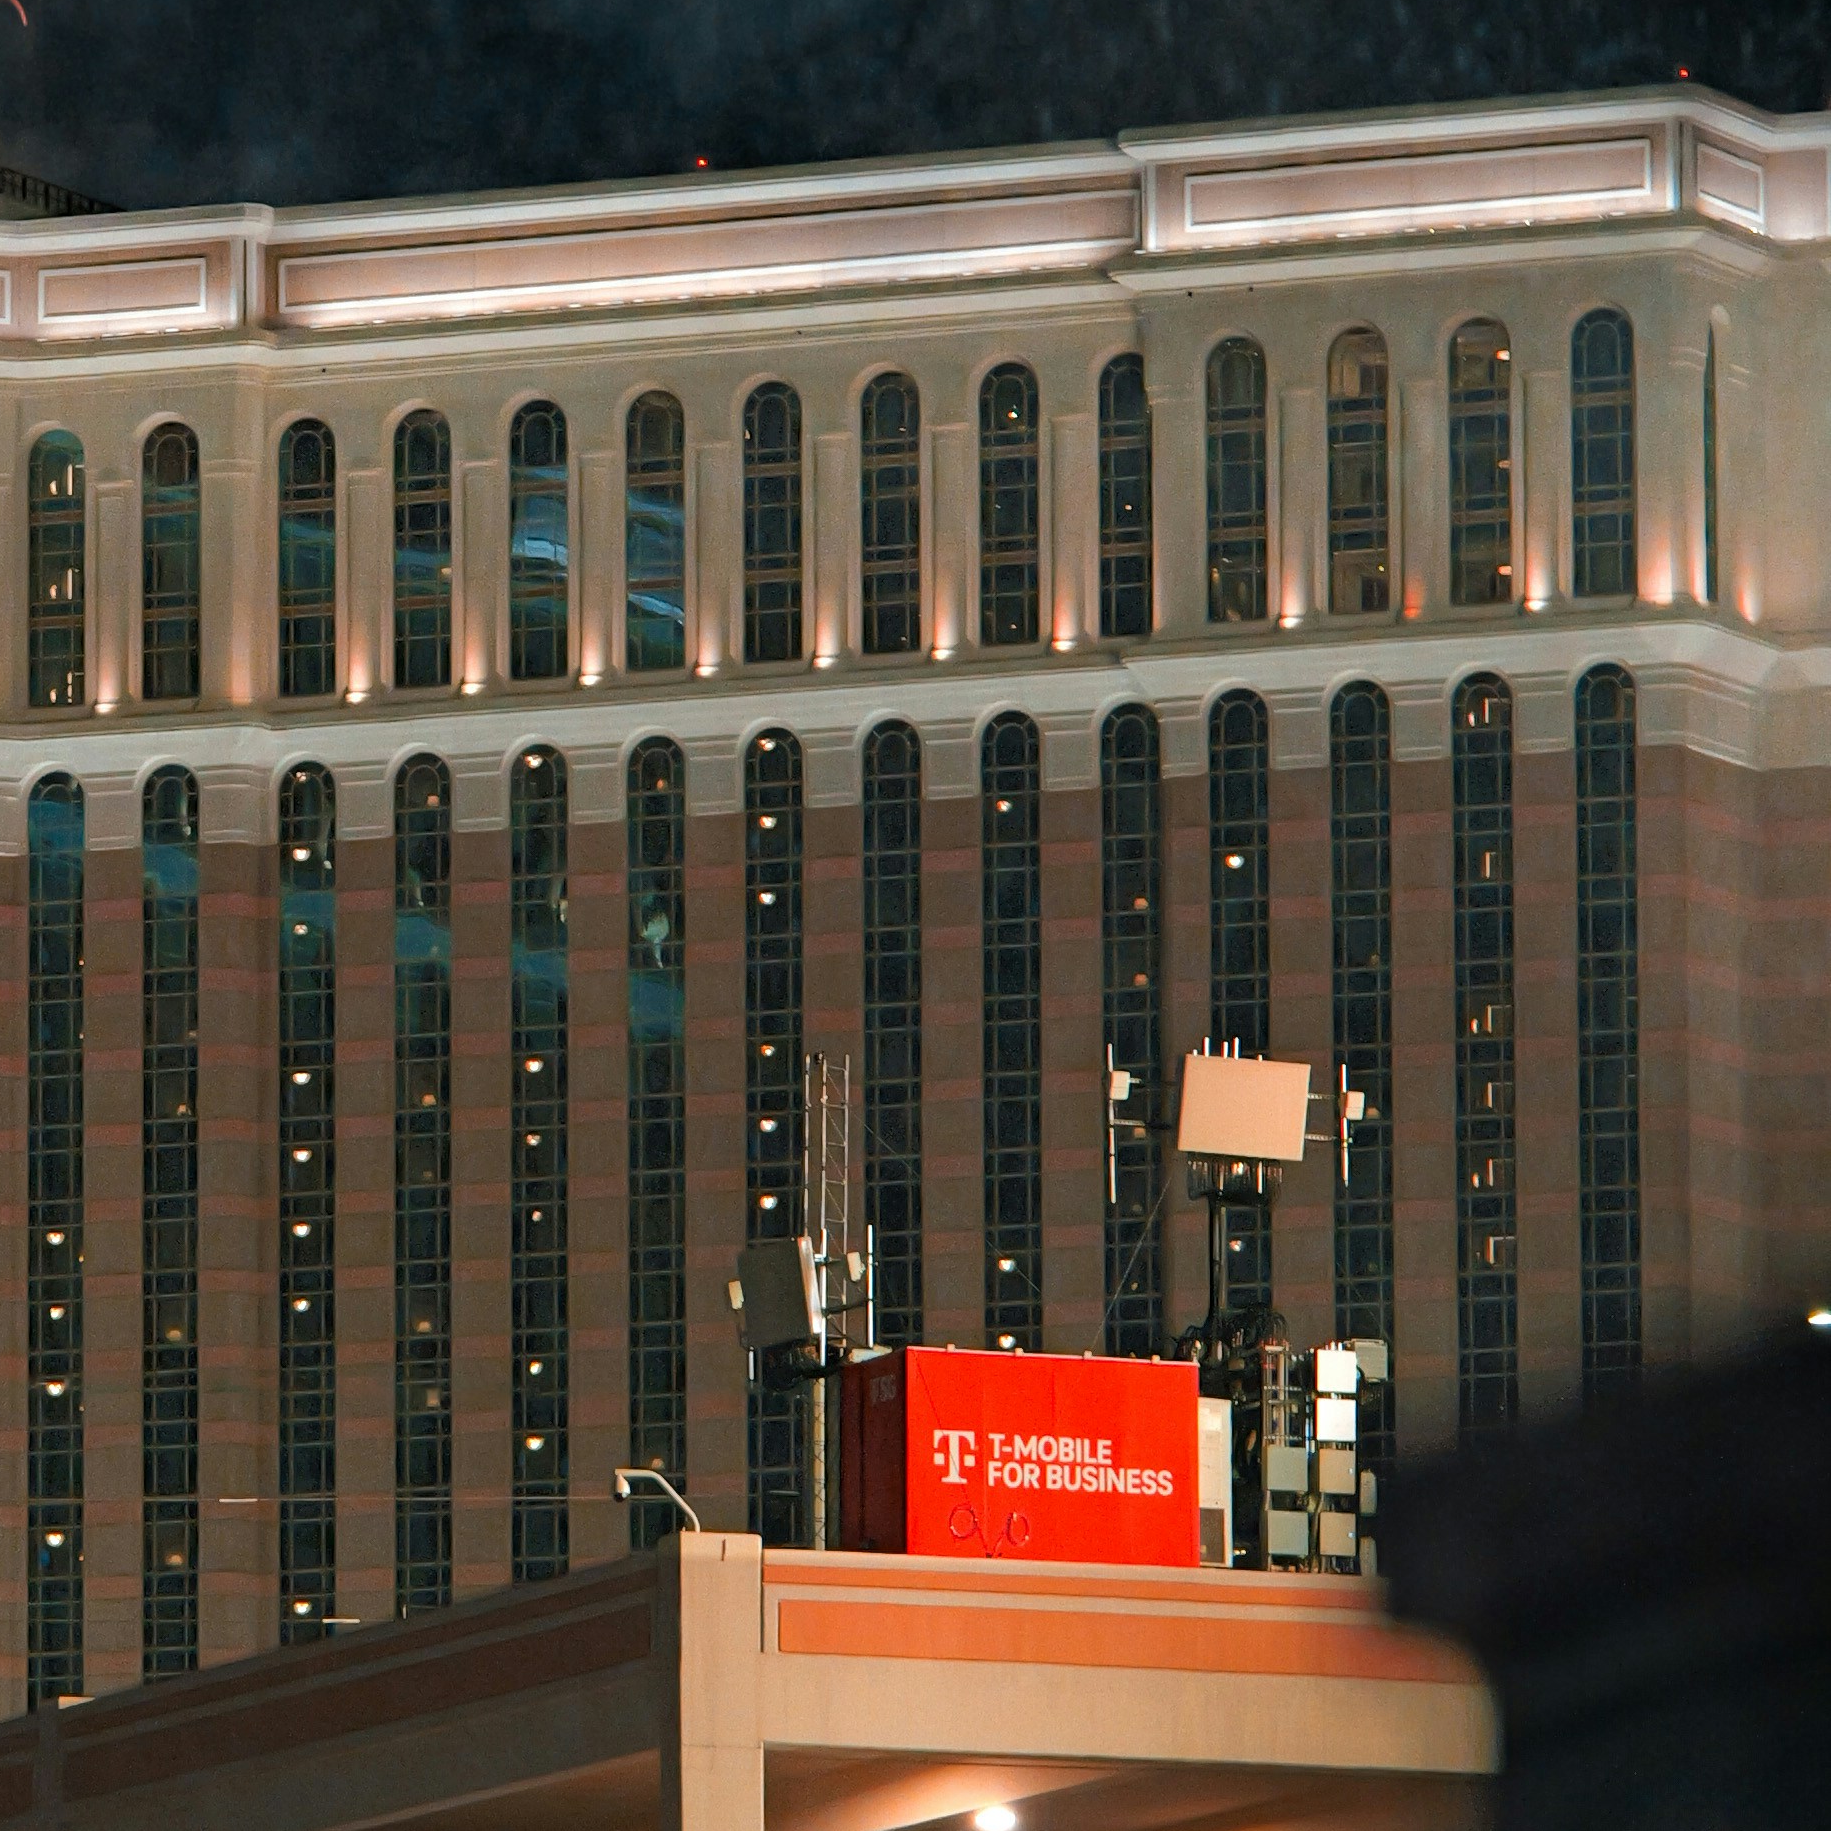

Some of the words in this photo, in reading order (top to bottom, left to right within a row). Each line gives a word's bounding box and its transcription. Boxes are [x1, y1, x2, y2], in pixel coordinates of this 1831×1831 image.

[934, 1429, 975, 1483] T
[988, 1433, 1112, 1465] T-MOBILE
[988, 1461, 1040, 1489] FOR
[1046, 1465, 1173, 1496] BUSINESS
